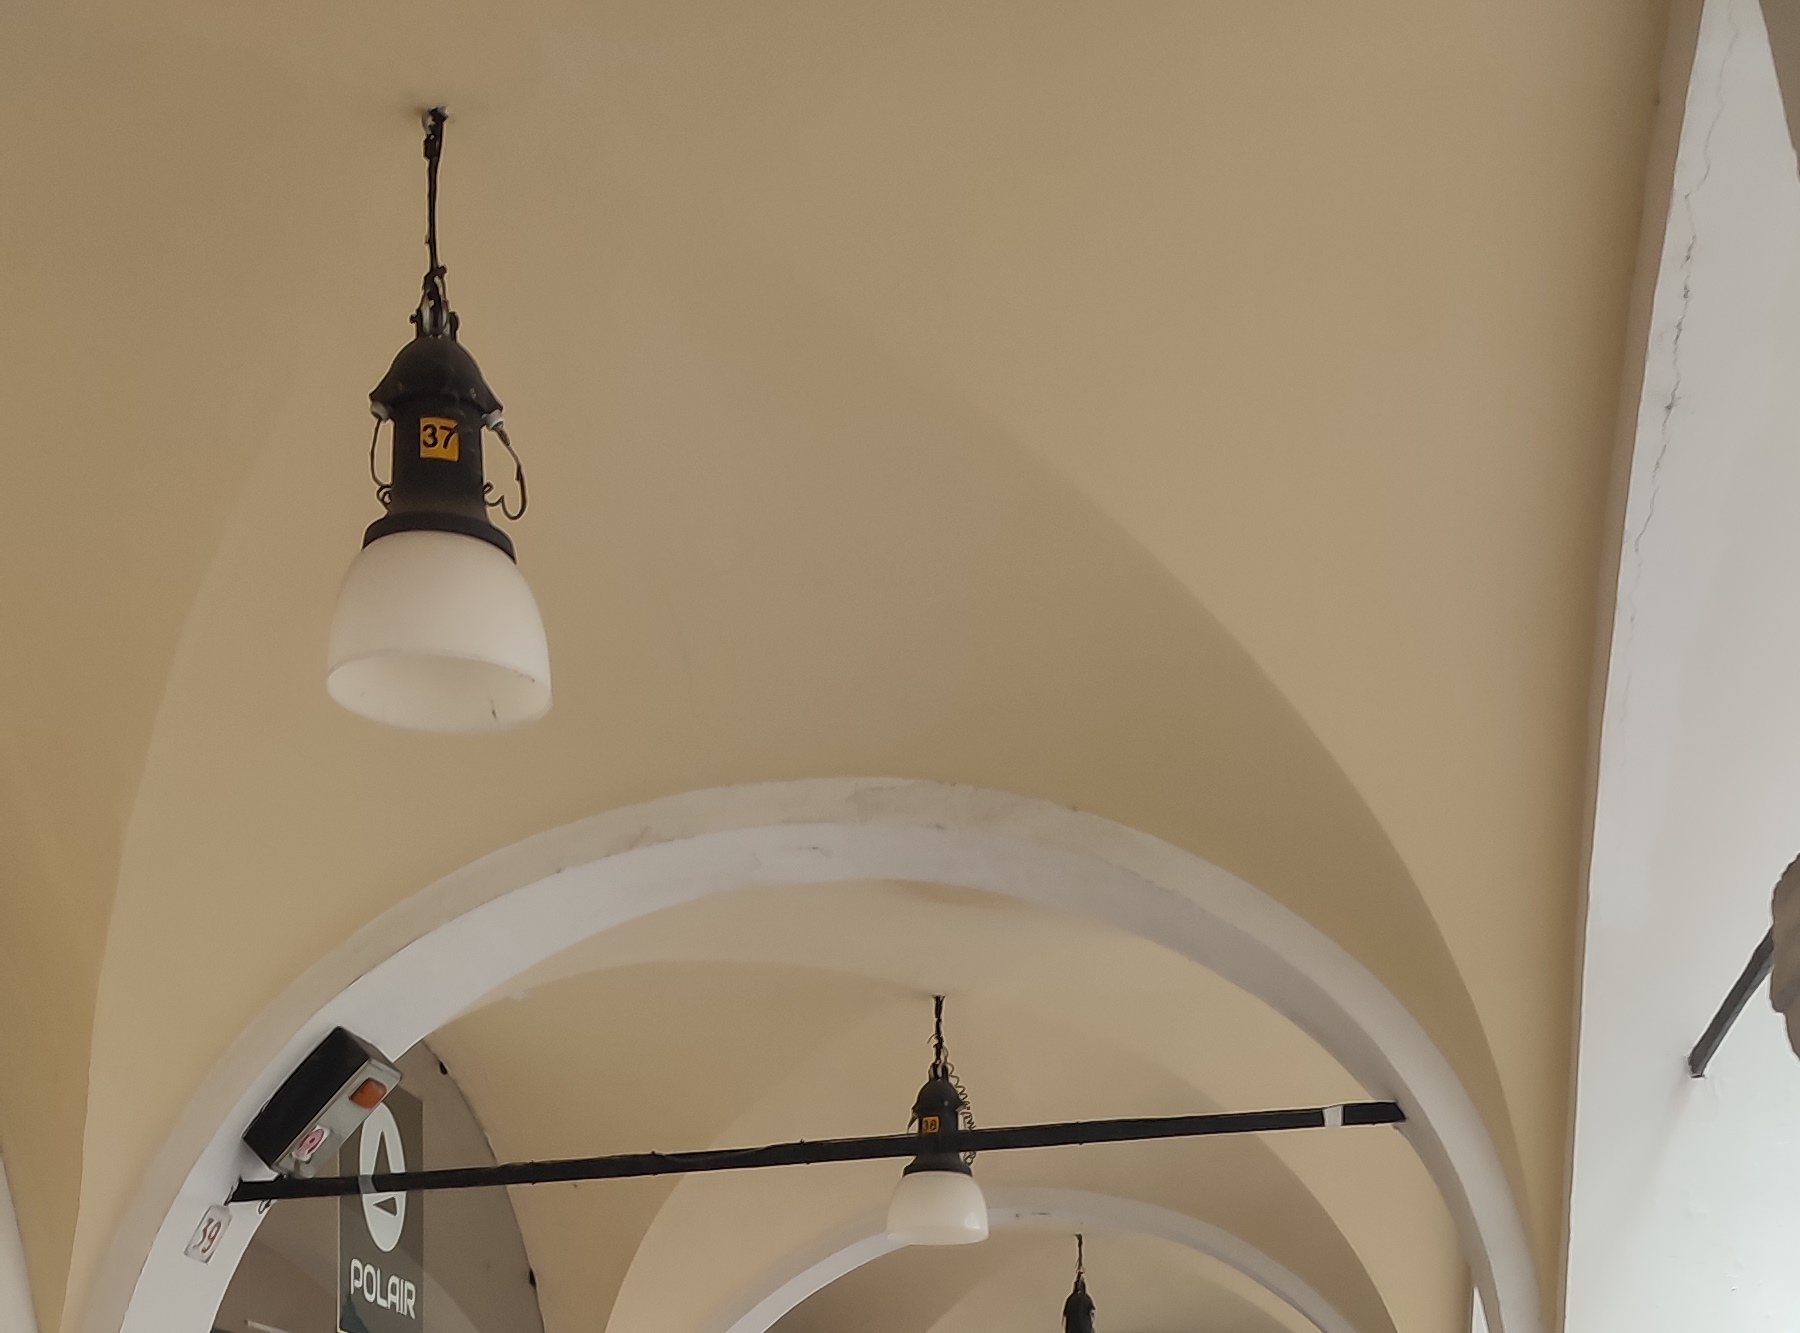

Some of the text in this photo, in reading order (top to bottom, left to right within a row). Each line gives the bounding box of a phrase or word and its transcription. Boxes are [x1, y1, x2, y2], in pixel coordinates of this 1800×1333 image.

[422, 423, 459, 450] 37
[192, 1218, 222, 1254] 39
[350, 1258, 416, 1320] POLAIR
